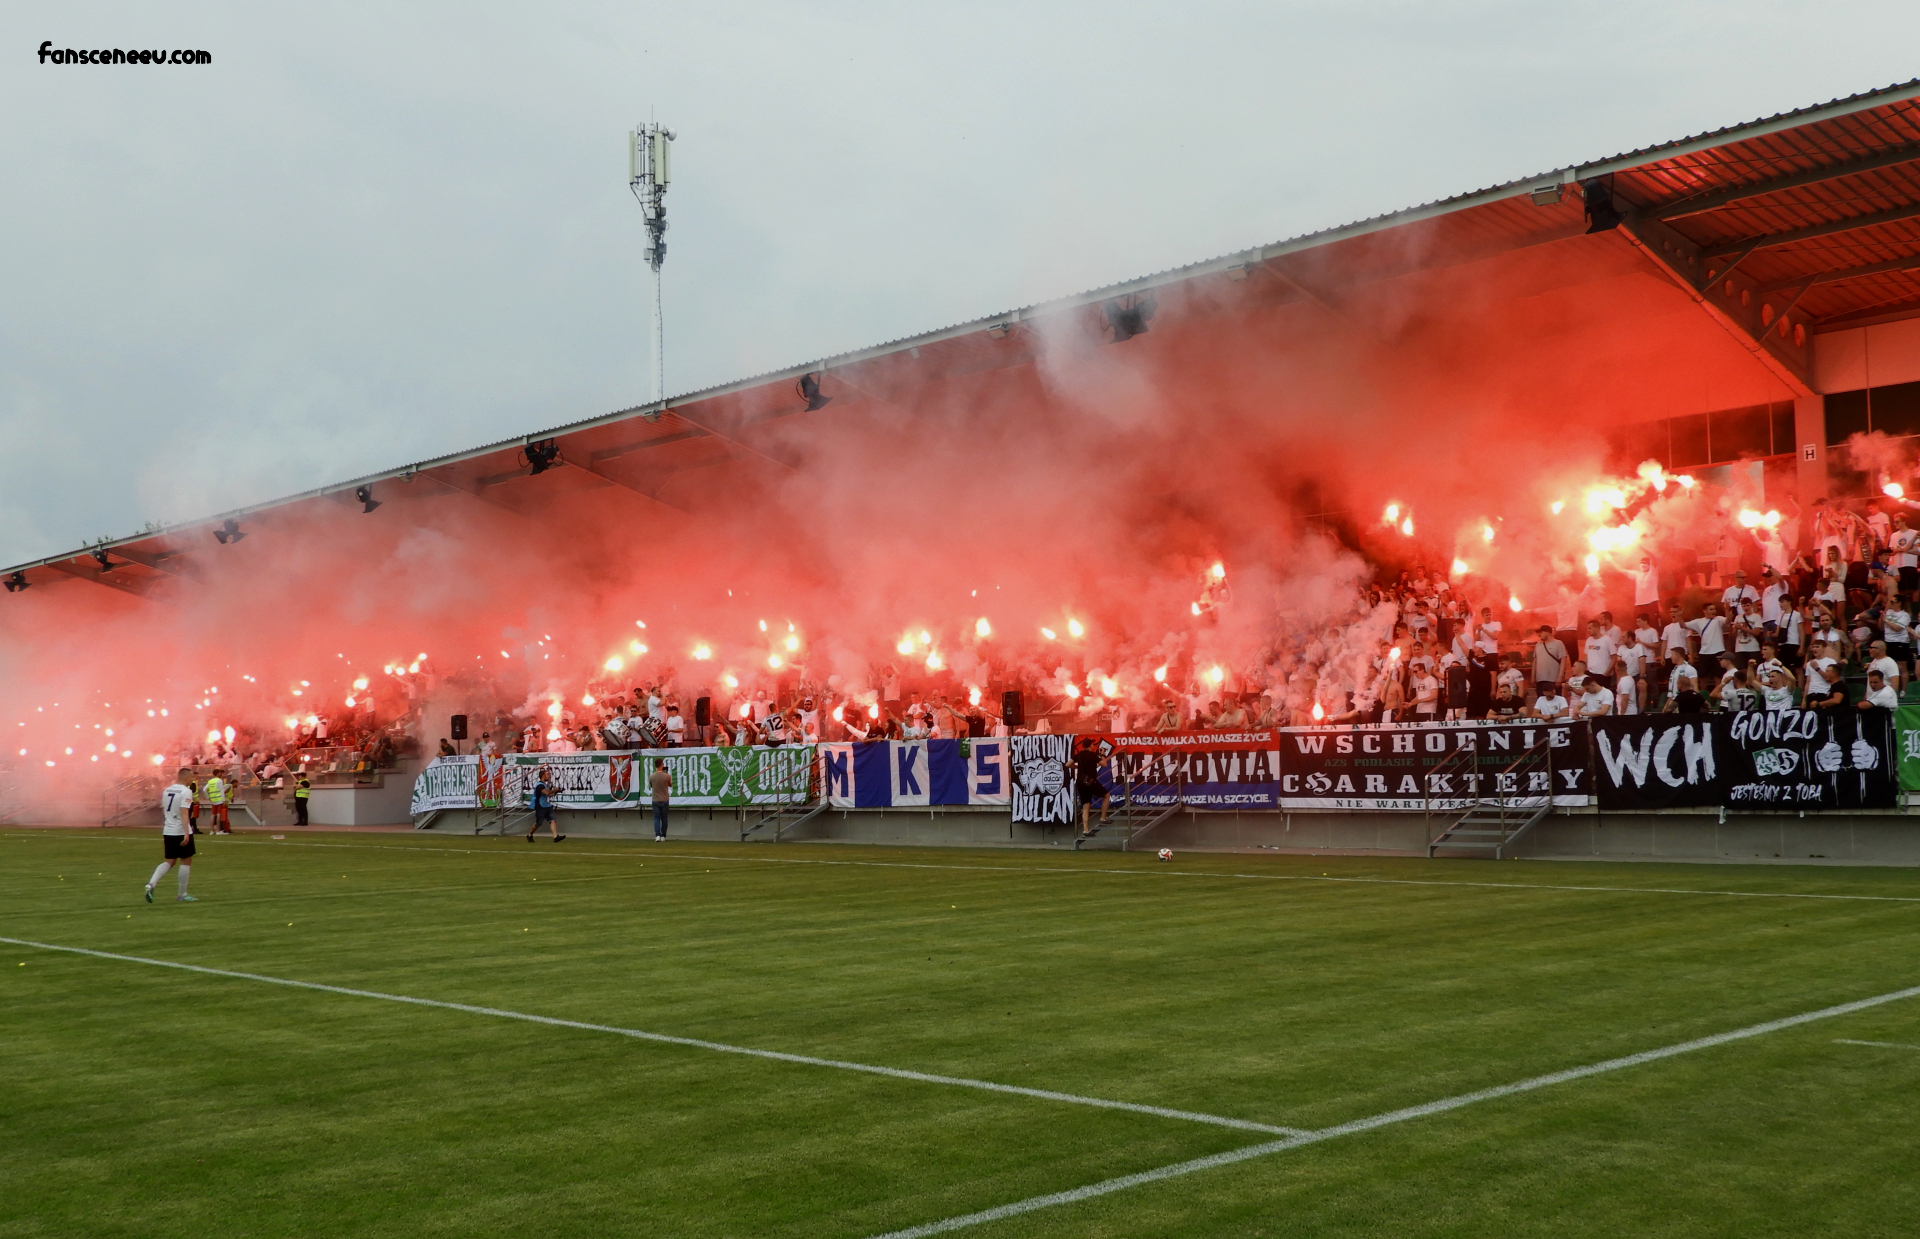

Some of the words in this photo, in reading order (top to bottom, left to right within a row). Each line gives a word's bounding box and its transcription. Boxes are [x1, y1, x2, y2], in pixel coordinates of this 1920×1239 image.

[1805, 449, 1815, 460] H
[1737, 695, 1756, 711] 12
[766, 716, 783, 731] 12
[1730, 709, 1818, 747] GONZO
[1115, 737, 1127, 746] TO
[1128, 736, 1159, 746] NASZA
[1197, 734, 1210, 744] TO
[1211, 733, 1242, 743] NASZE
[1295, 727, 1571, 754] WSCHODNIE
[1010, 734, 1075, 769] SPORTOWY
[1596, 722, 1716, 788] WCH
[1115, 749, 1274, 786] MAZOVIA
[1324, 759, 1347, 767] AZS
[1354, 758, 1415, 767] PODLASIE
[643, 754, 711, 796] UTRAS
[1208, 794, 1223, 804] NA
[1782, 785, 1792, 801] Z
[166, 793, 176, 812] 7
[1336, 800, 1363, 808] NIE
[1375, 800, 1423, 808] WART
